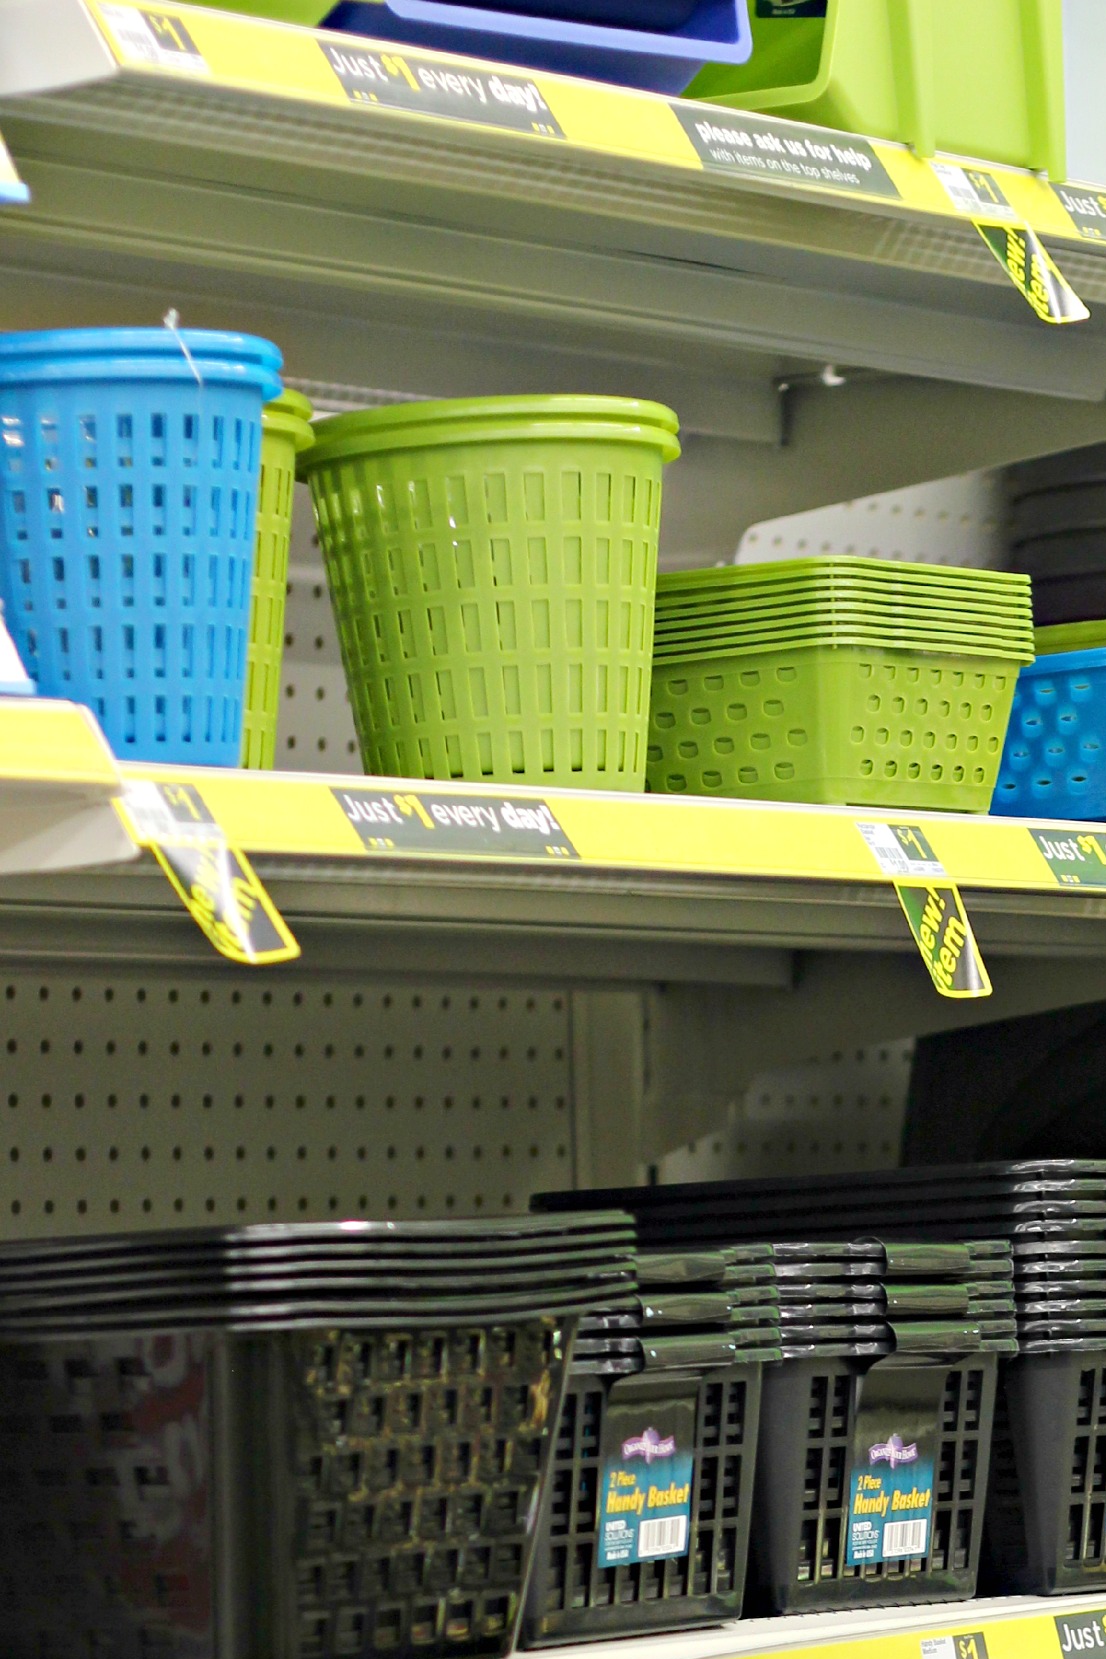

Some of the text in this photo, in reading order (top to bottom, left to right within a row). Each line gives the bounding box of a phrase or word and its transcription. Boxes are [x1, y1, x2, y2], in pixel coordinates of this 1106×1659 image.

[330, 47, 547, 113] Just $1 every day!
[695, 121, 872, 171] please ask us for help
[709, 148, 860, 184] with items on the top shelves
[968, 172, 999, 204] $1
[1060, 190, 1106, 218] Just
[163, 785, 201, 821] $1
[343, 794, 560, 835] Just $1 every day!
[897, 829, 927, 859] $1
[1039, 836, 1085, 862] Just
[933, 917, 967, 989] item
[606, 1482, 690, 1515] Handy Basket
[853, 1487, 931, 1517] Handy Basket
[1062, 1620, 1105, 1652] Just
